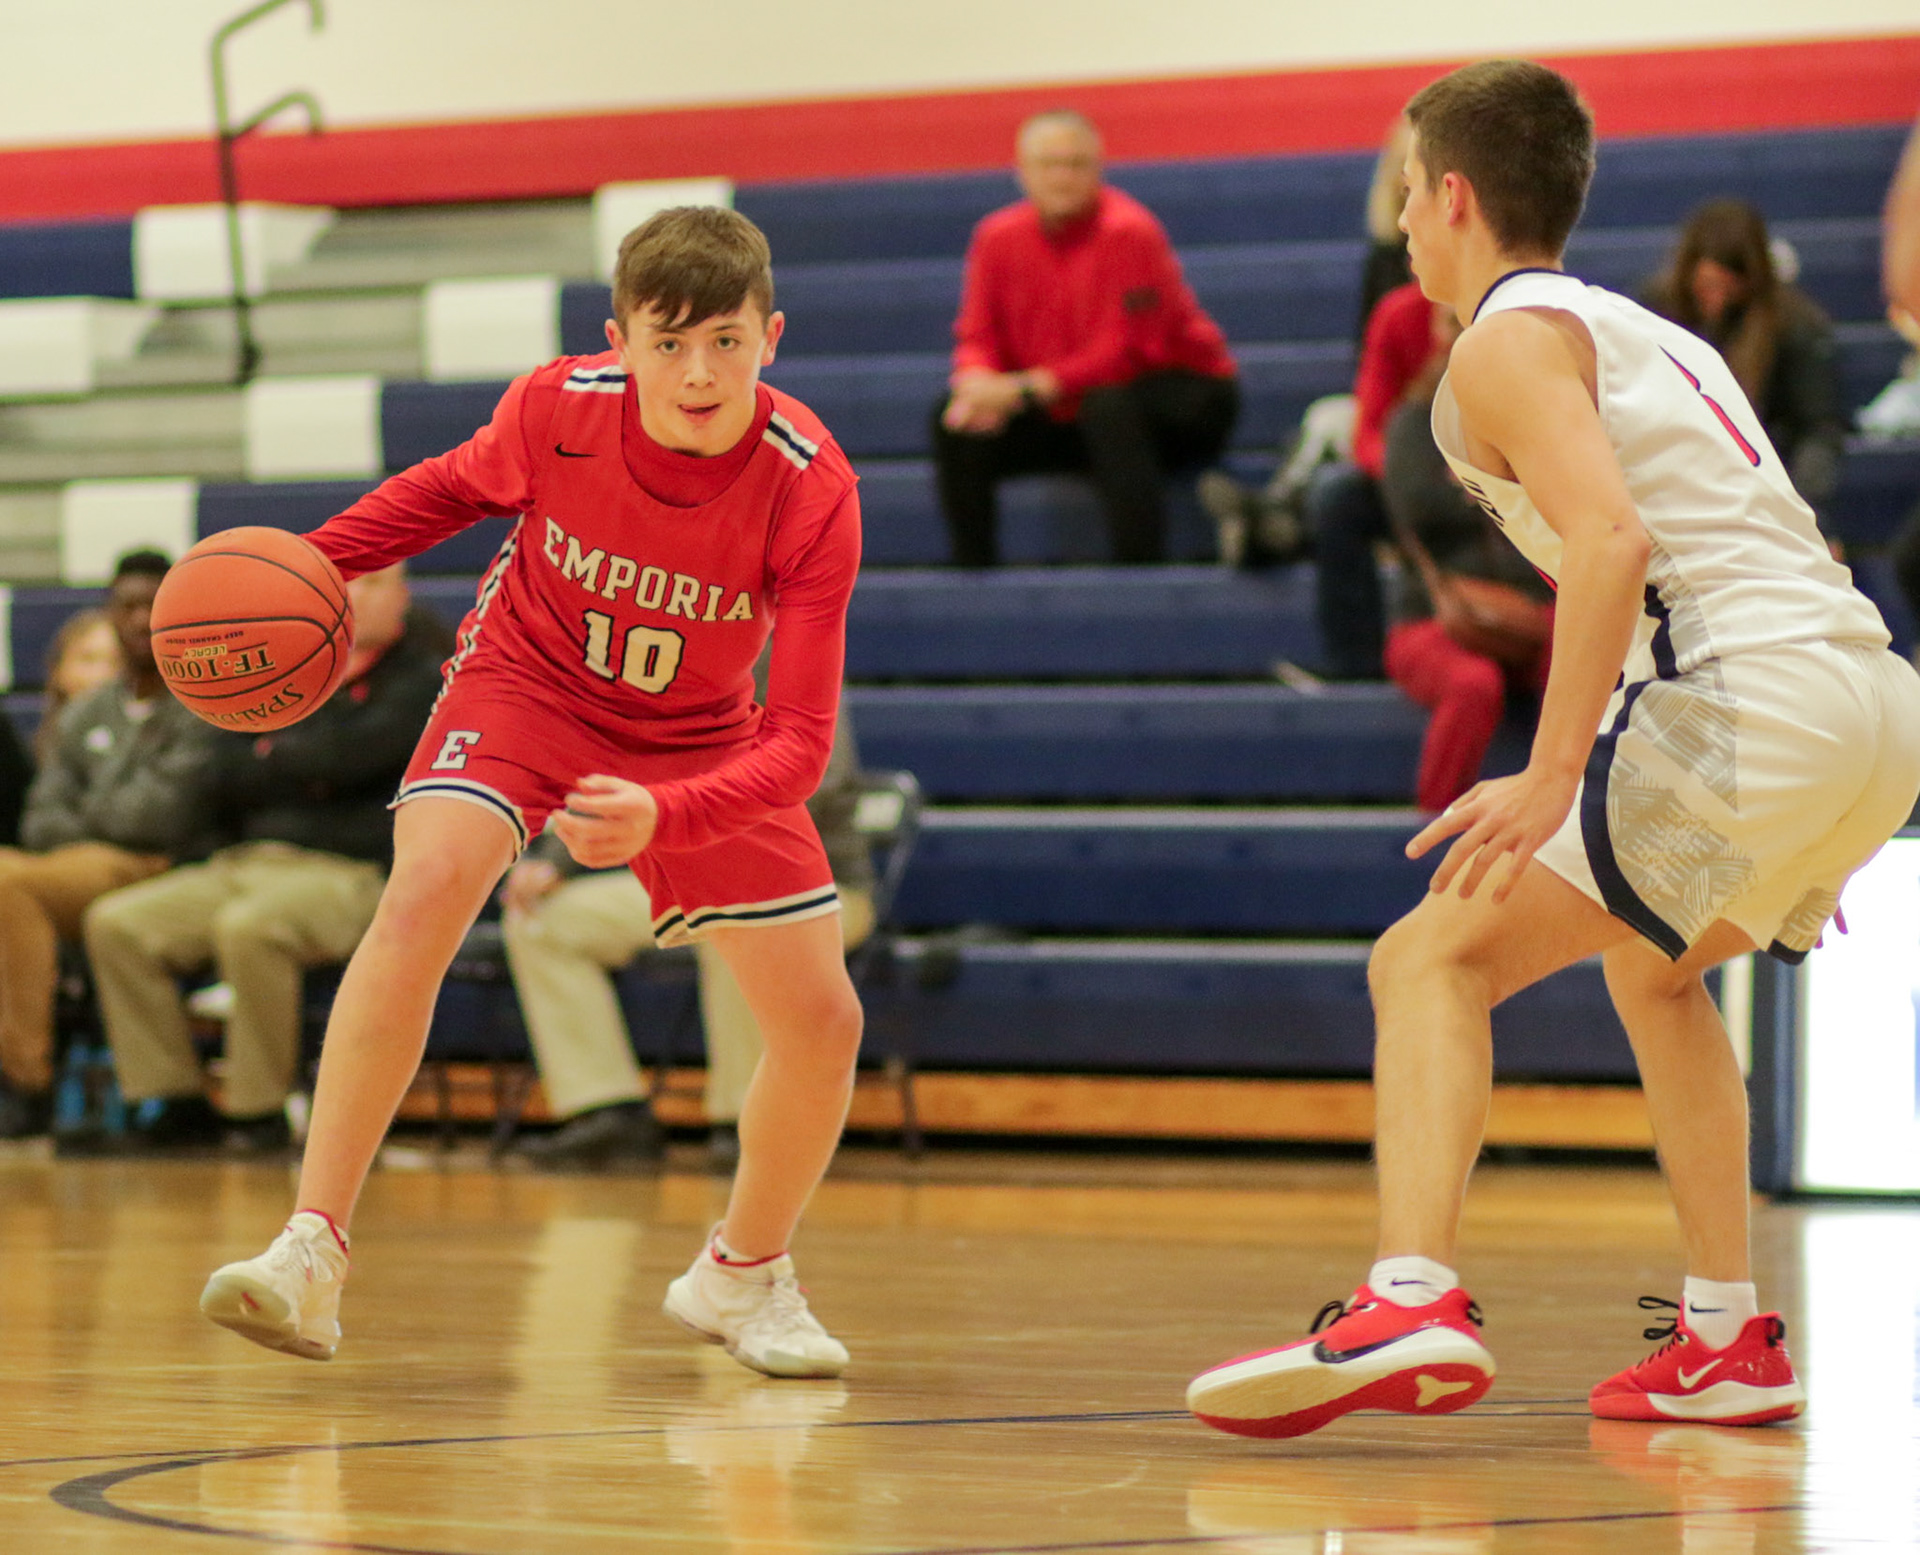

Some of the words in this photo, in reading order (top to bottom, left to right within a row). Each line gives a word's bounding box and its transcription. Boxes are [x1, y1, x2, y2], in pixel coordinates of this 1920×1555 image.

[544, 516, 753, 622] EMPORIA
[184, 645, 227, 658] LEGACY
[583, 608, 686, 694] 10
[429, 730, 483, 770] E
